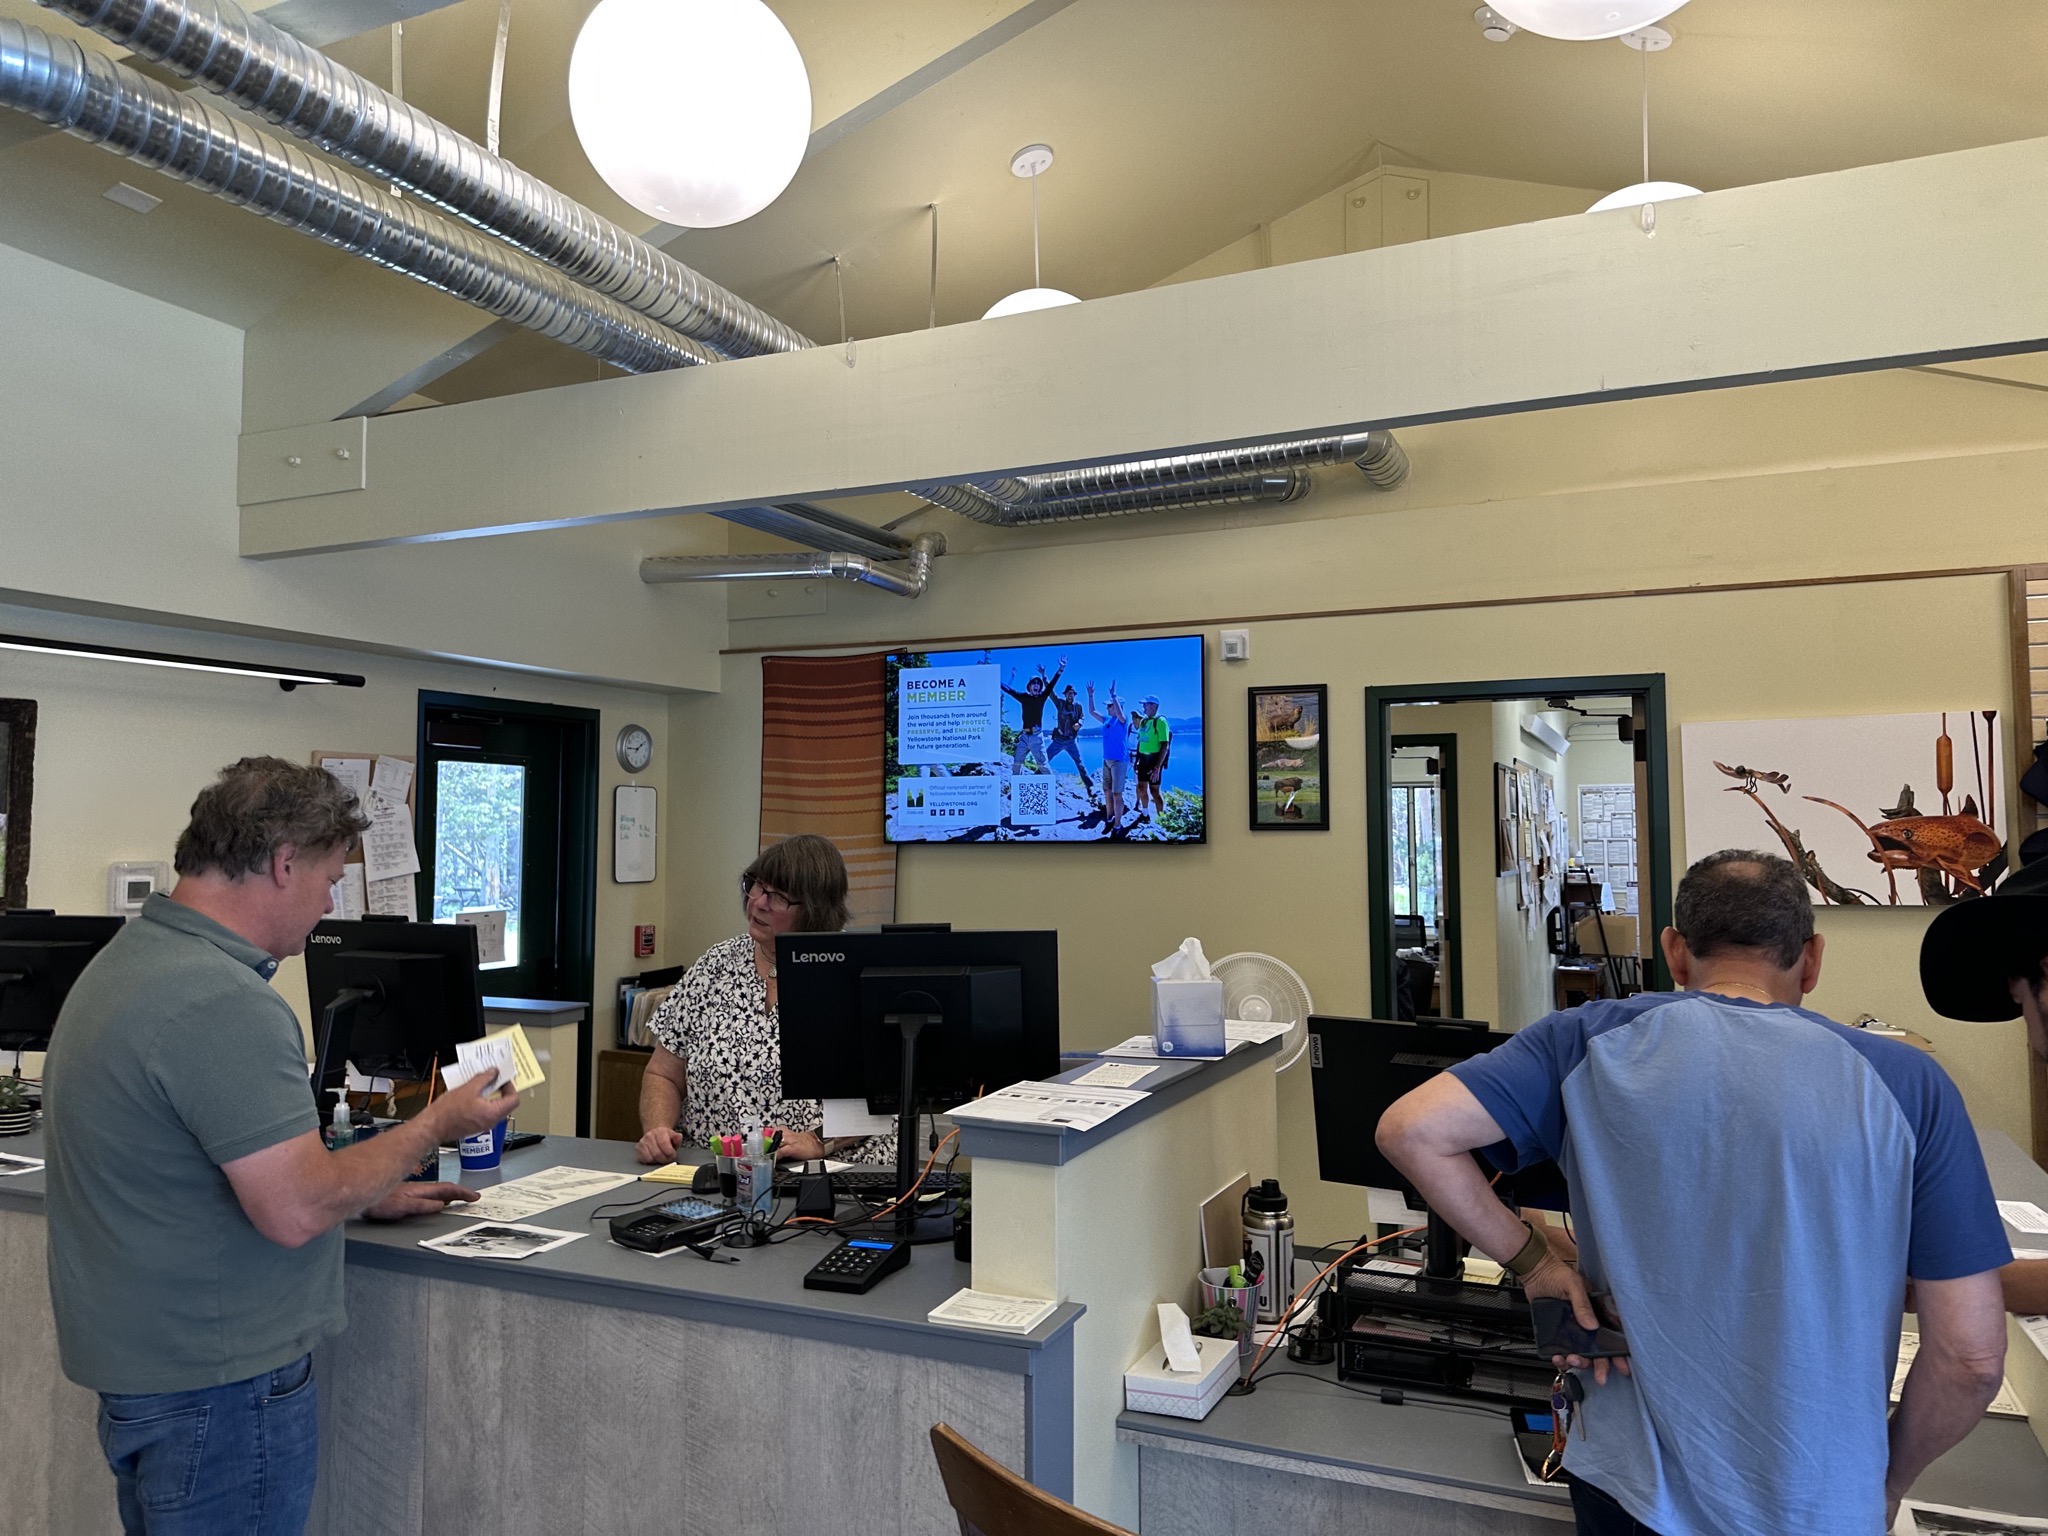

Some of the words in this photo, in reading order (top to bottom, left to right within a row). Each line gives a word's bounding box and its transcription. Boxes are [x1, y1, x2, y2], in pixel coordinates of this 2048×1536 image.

[907, 680, 954, 689] BECOME
[958, 678, 966, 687] A
[907, 691, 966, 702] MEMBER
[935, 742, 970, 750] generations.
[310, 933, 342, 944] Lenovo
[792, 951, 846, 963] Lenovo
[462, 1146, 490, 1154] MEMBER
